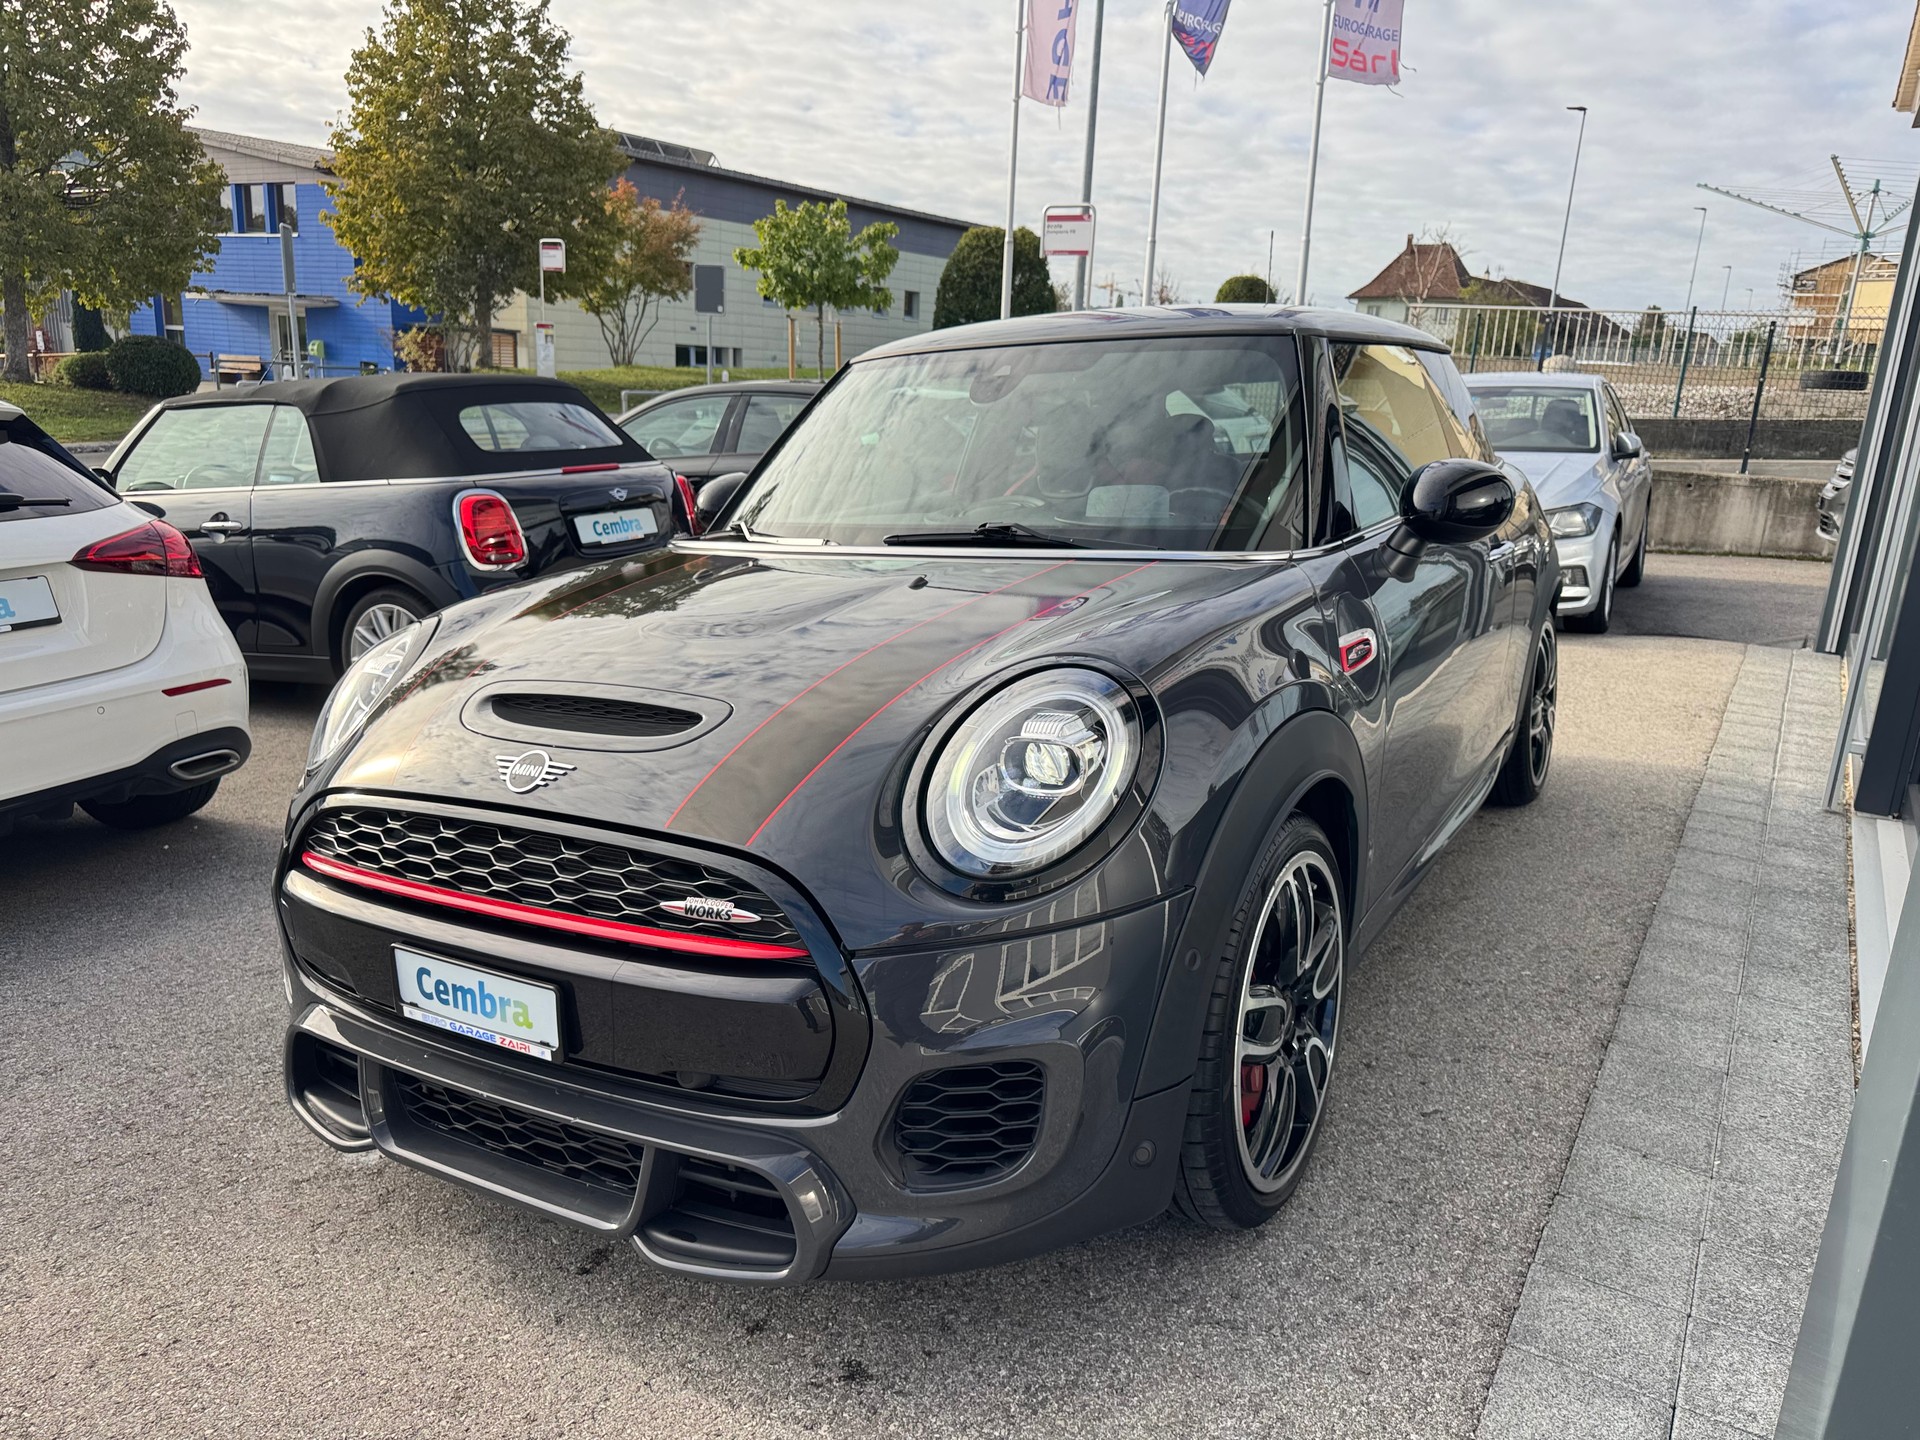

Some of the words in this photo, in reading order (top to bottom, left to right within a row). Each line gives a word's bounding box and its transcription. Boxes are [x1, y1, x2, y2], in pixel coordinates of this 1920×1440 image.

[592, 516, 643, 536] Cembra
[512, 764, 542, 777] MINI
[684, 904, 733, 920] WORKS
[706, 901, 734, 909] COOPER
[416, 967, 533, 1029] Cembra
[450, 1022, 497, 1043] GARAGE
[499, 1036, 531, 1053] ZAIRI
